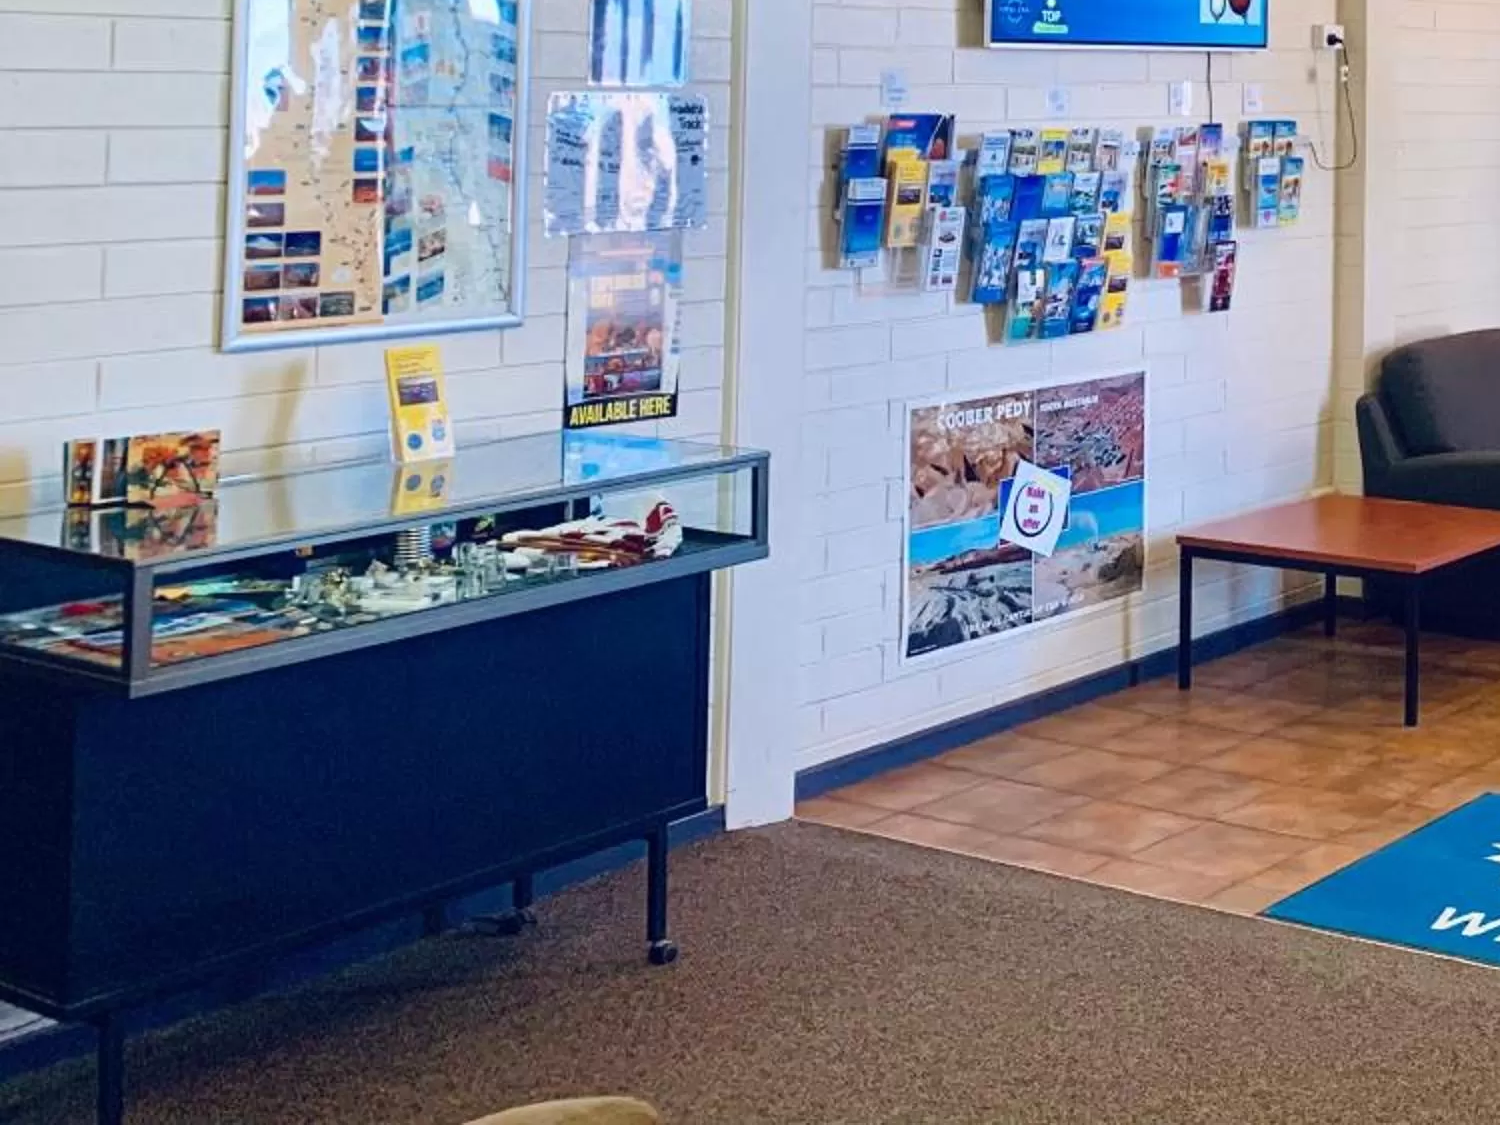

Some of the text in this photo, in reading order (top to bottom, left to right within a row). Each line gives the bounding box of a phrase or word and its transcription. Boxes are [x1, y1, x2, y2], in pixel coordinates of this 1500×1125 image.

[1042, 10, 1062, 22] TOP
[569, 394, 672, 426] AVAILABLE HERE
[937, 400, 1032, 431] COOBER PEDY
